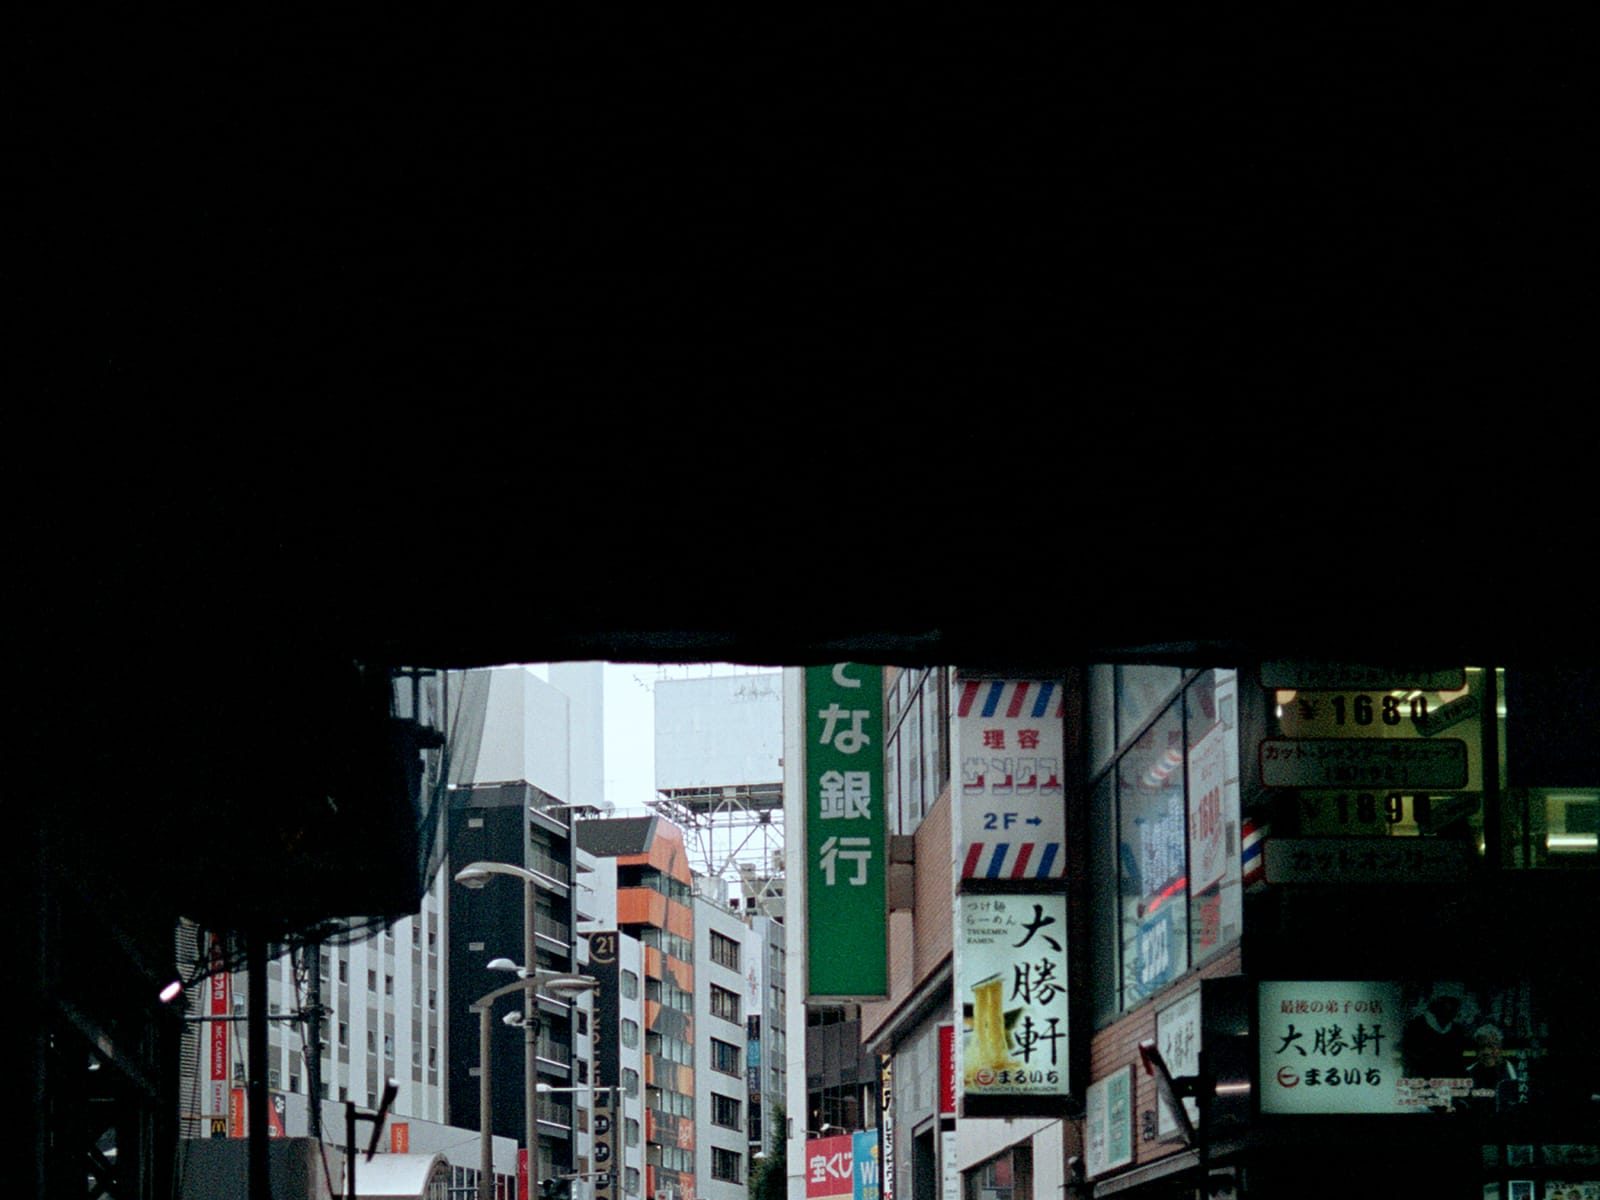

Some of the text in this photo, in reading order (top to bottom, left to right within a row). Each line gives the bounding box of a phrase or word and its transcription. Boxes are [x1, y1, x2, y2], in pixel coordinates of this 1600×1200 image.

[983, 729, 1040, 749] 理容
[984, 812, 1018, 830] 2F
[966, 914, 1016, 925] らーめん
[596, 936, 615, 954] 21
[1010, 904, 1066, 1066] 大勝軒
[1280, 999, 1384, 1014] 最後の弟子の店
[1275, 1023, 1386, 1057] 大勝軒
[999, 1069, 1060, 1085] まるいち
[1304, 1067, 1381, 1086] まるいち
[811, 1152, 853, 1183] 宝くじ
